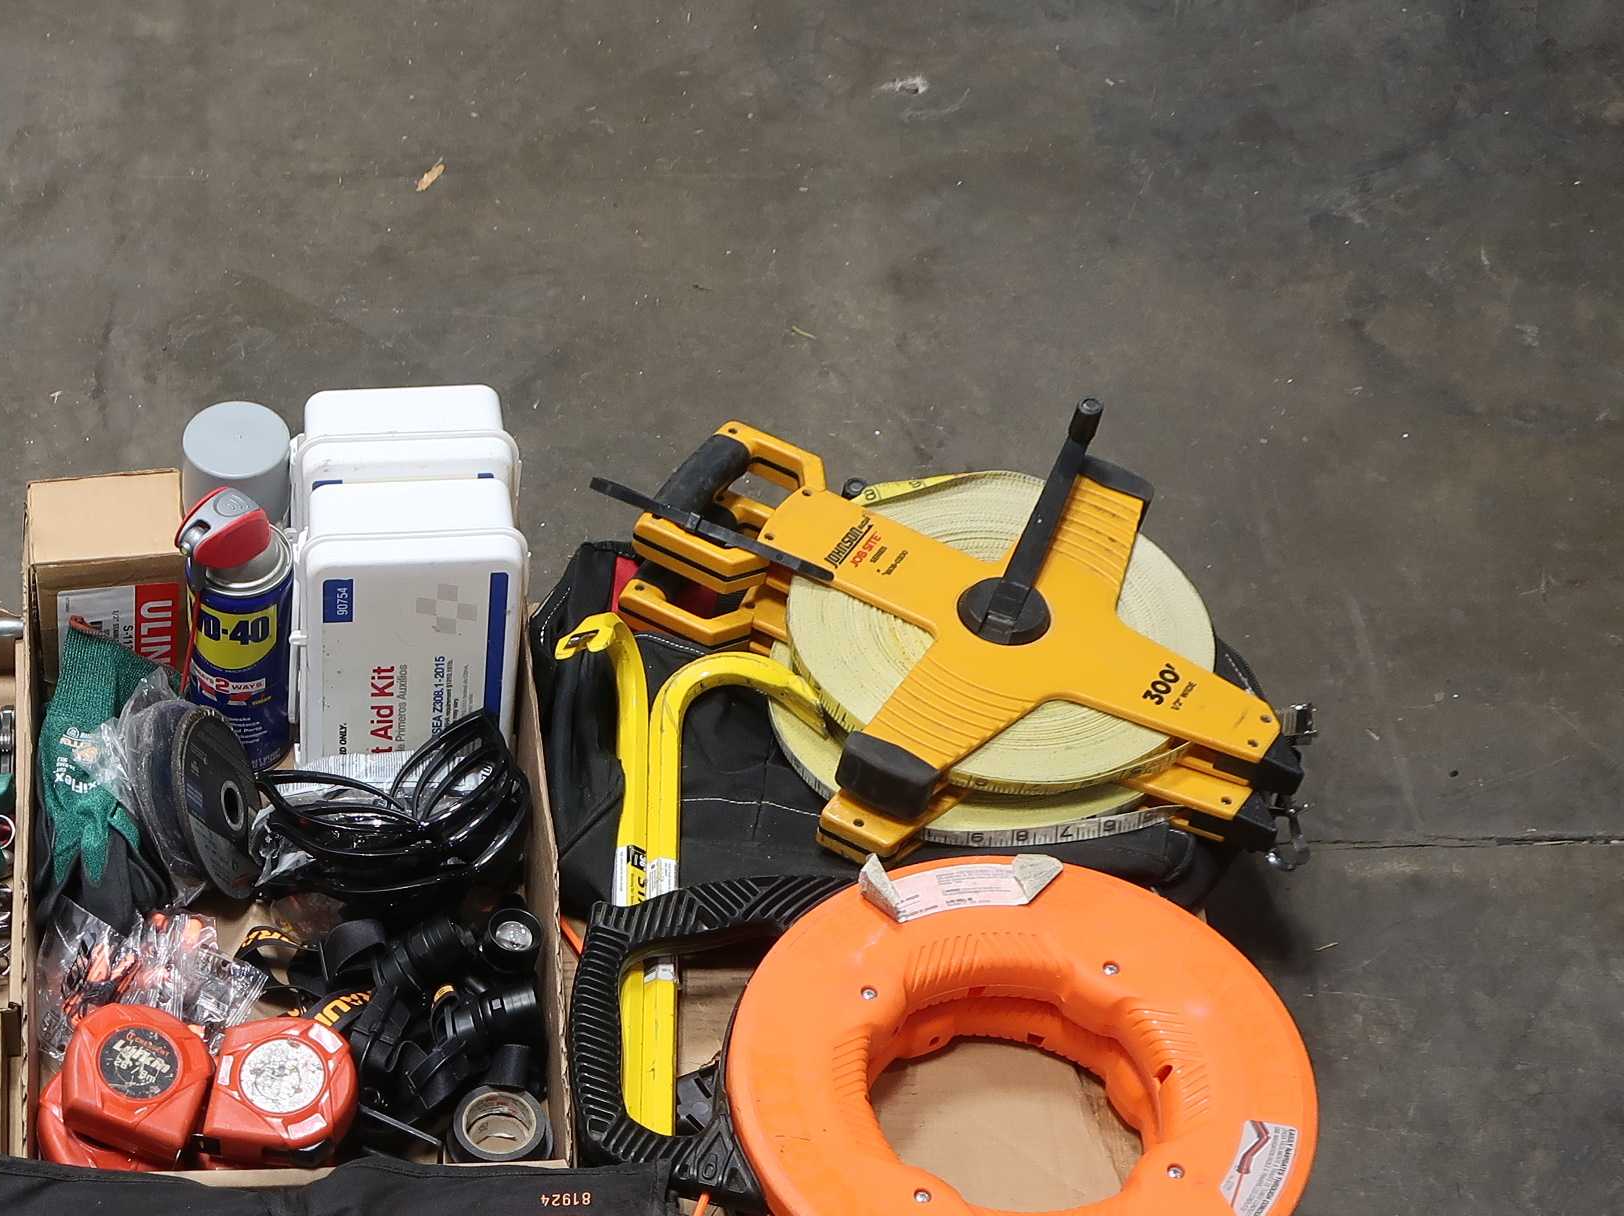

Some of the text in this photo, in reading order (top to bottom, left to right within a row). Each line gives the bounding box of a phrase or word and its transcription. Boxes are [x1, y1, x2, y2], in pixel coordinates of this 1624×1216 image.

[824, 526, 863, 569] JOHNSON
[850, 550, 869, 568] JOB
[862, 531, 882, 553] SITE
[337, 588, 348, 616] 90754
[216, 677, 230, 694] 2
[231, 681, 265, 691] WAYS
[370, 665, 395, 697] Kit
[395, 664, 408, 700] Auxilios
[433, 656, 446, 713] Z308.1-2015
[1142, 663, 1180, 705] 300'
[339, 722, 347, 745] ONLY.
[370, 705, 394, 741] Aid
[395, 702, 407, 742] Primeros
[540, 1193, 592, 1206] 81924
